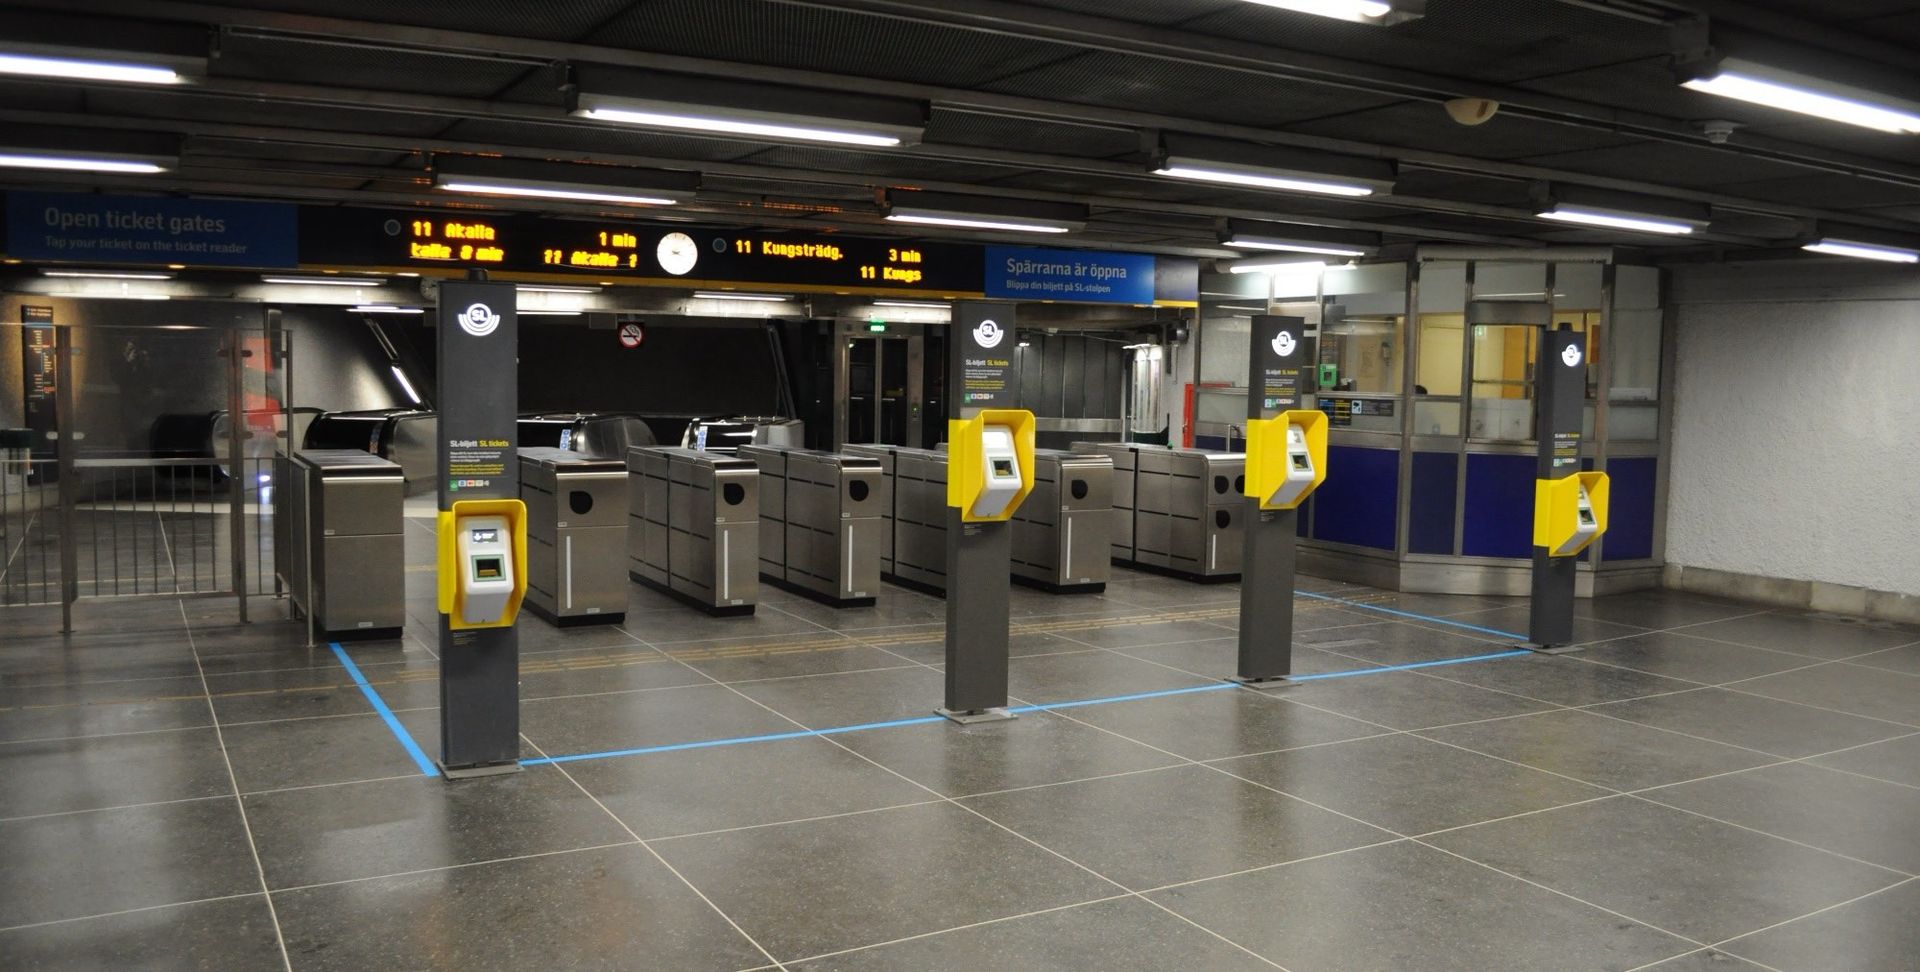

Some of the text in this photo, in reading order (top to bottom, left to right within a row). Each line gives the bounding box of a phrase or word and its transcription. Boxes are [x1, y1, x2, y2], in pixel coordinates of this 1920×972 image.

[44, 207, 226, 235] Open ticket gates
[45, 235, 247, 254] Tap your ticket on the ticket reader
[412, 221, 637, 248] 11 Akalla 1 min
[735, 239, 922, 263] 11 Kungsträdg. 3 min
[860, 265, 922, 283] 11 Kungs
[1007, 257, 1127, 281] Spärrarna är öppna
[1006, 279, 1111, 294] Blippa din biljett på SL-stolpen
[471, 309, 488, 321] SL
